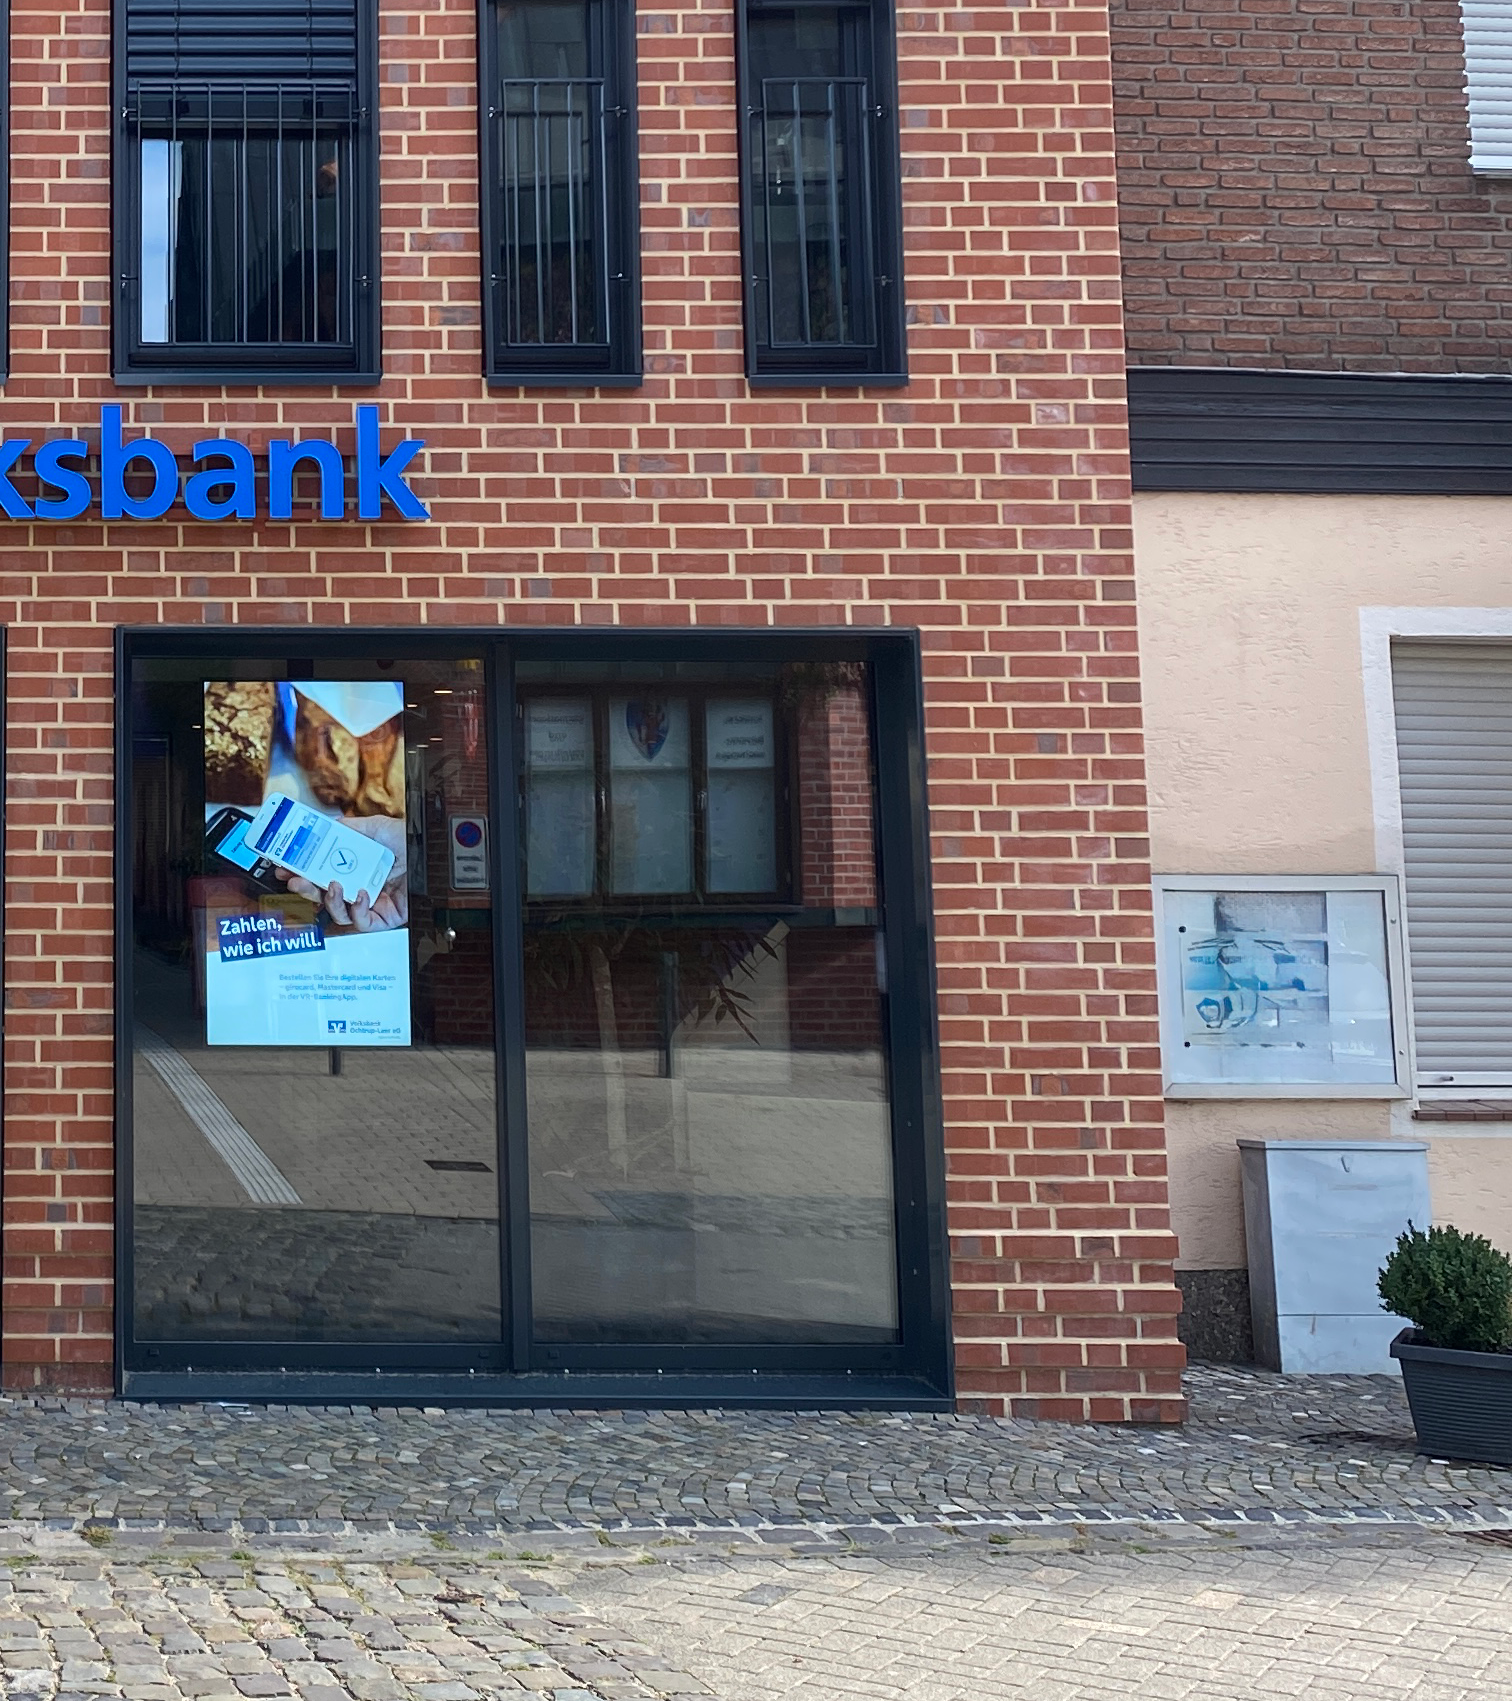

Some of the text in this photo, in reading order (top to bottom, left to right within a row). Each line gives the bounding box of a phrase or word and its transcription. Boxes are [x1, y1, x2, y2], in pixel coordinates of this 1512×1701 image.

[220, 916, 282, 936] Zahlen,
[222, 931, 322, 958] wie ich will.
[340, 974, 371, 982] digitalen
